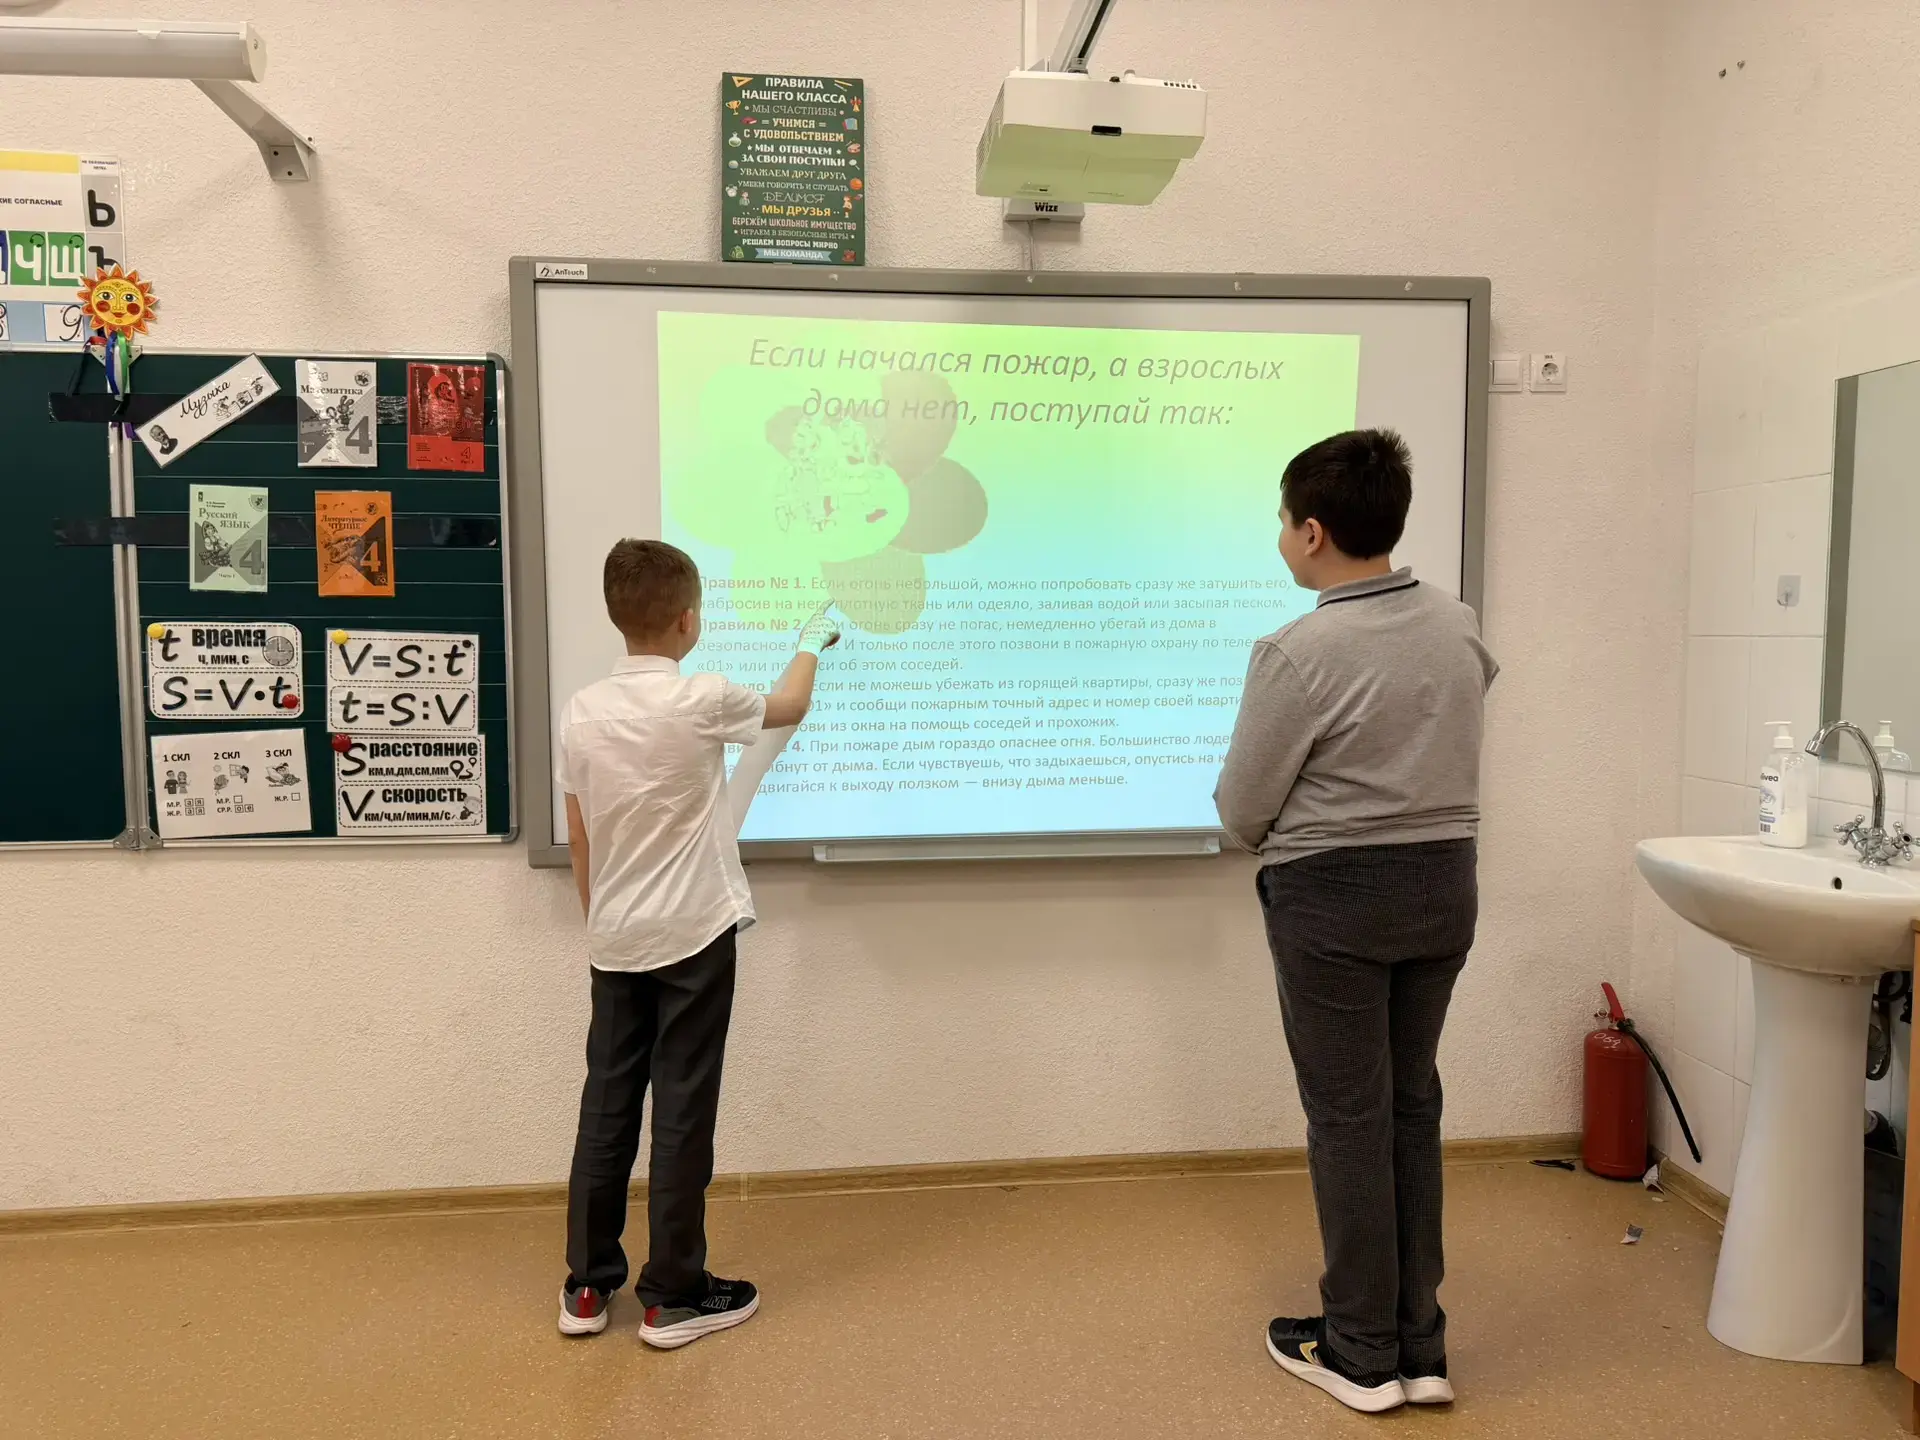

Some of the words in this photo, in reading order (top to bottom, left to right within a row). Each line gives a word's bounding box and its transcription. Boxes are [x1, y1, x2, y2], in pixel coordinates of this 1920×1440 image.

[765, 77, 824, 90] ПРАВИЛА
[741, 89, 794, 101] НАШЕГО
[796, 92, 848, 104] КЛАССА
[752, 104, 770, 114] МЫ
[772, 105, 838, 117] СЧАСТЛИВЫ
[772, 117, 816, 129] УЧИМСЯ
[743, 128, 751, 138] С
[753, 129, 845, 143] УДОВОЛЬСТВИЕМ
[755, 143, 775, 154] МЫ
[779, 144, 832, 156] ОТВЕЧАЕМ
[741, 153, 755, 163] ЗА
[756, 154, 786, 164] СВОИ
[789, 155, 846, 167] ПОСТУПКИ
[739, 167, 790, 178] УВАЖАЕМ
[791, 169, 816, 180] ДРУГ
[816, 170, 847, 180] ДРУГА
[737, 180, 766, 189] УМЕЕМ
[766, 180, 805, 190] ГОВОРИТЬ
[812, 183, 849, 193] СЛУШАТЬ
[14, 198, 63, 206] СОГЛАСНЫЕ
[761, 204, 784, 215] МЫ
[785, 206, 831, 217] ДРУЗЬЯ
[769, 218, 808, 229] ШКОЛЬНОЕ
[810, 220, 857, 231] ИМУЩЕСТВО
[742, 238, 774, 246] РЕШАЕМ
[775, 239, 811, 248] ВОПРОСЫ
[812, 241, 838, 250] МИРНО
[15, 243, 42, 281] Ч
[763, 249, 779, 257] МЫ
[780, 249, 824, 260] КОМАНДА
[749, 338, 826, 369] Если
[837, 348, 972, 374] начался
[982, 353, 1097, 383] пожар,
[1109, 356, 1128, 377] а
[1137, 357, 1285, 385] взрослых
[179, 381, 231, 420] Музыка
[802, 388, 890, 420] дома
[901, 399, 979, 426] нет,
[990, 397, 1151, 430] поступай
[1159, 403, 1234, 426] так:
[345, 415, 373, 455] 4
[198, 507, 239, 520] Русский
[239, 539, 265, 575] 4
[360, 541, 381, 572] 4
[699, 577, 766, 593] Правило
[770, 576, 789, 589] №
[811, 578, 846, 590] Если
[895, 578, 984, 592] небольшой,
[987, 580, 1037, 591] можно
[1040, 578, 1132, 592] попробовать
[1135, 579, 1174, 591] сразу
[1177, 579, 1196, 589] же
[1199, 579, 1262, 591] затушить
[1265, 579, 1291, 592] его,
[775, 600, 794, 610] на
[902, 600, 942, 610] ткань
[947, 600, 974, 610] или
[978, 600, 1033, 612] одеяло,
[1037, 600, 1093, 610] заливая
[1098, 597, 1140, 611] водой
[1144, 599, 1169, 609] или
[1174, 598, 1230, 609] засыпая
[1233, 598, 1286, 609] песком.
[699, 618, 766, 634] Правило
[770, 618, 788, 630] №
[894, 620, 934, 632] сразу
[939, 620, 956, 630] не
[960, 620, 1002, 632] погас,
[1006, 620, 1096, 632] немедленно
[1100, 617, 1146, 632] убегай
[1150, 619, 1165, 629] из
[1169, 619, 1205, 631] дома
[697, 639, 787, 651] безопасное
[859, 640, 908, 651] только
[912, 640, 955, 650] после
[959, 640, 996, 650] этого
[1000, 640, 1059, 650] позвони
[1075, 639, 1147, 651] пожарную
[1150, 638, 1198, 651] охрану
[1202, 638, 1219, 648] по
[697, 659, 733, 672] «01»
[739, 661, 767, 672] или
[839, 659, 858, 671] об
[861, 661, 897, 671] этом
[900, 657, 964, 672] соседей.
[848, 682, 866, 691] не
[869, 681, 932, 691] можешь
[936, 677, 994, 692] убежать
[998, 680, 1014, 689] из
[1018, 676, 1078, 691] горящей
[1082, 678, 1152, 691] квартиры,
[1156, 677, 1193, 690] сразу
[1197, 677, 1216, 687] же
[849, 699, 907, 712] сообщи
[911, 699, 989, 712] пожарным
[992, 696, 1044, 709] точный
[1048, 698, 1089, 711] адрес
[1105, 698, 1151, 710] номер
[1154, 694, 1193, 707] своей
[830, 721, 847, 732] из
[850, 720, 885, 731] окна
[889, 720, 907, 731] на
[911, 719, 970, 732] помощь
[973, 716, 1031, 731] соседей
[1047, 717, 1120, 730] прохожих.
[369, 741, 478, 759] расстояние
[810, 740, 839, 754] При
[843, 740, 899, 753] пожаре
[902, 740, 936, 752] дым
[939, 739, 996, 752] гораздо
[999, 737, 1057, 748] опаснее
[1060, 737, 1095, 747] огня.
[1099, 734, 1191, 747] Большинство
[163, 754, 169, 762] 1
[171, 753, 191, 762] СКЛ
[213, 752, 220, 760] 2
[221, 751, 241, 760] СКЛ
[265, 749, 272, 758] 3
[273, 749, 293, 757] СКЛ
[812, 762, 828, 772] от
[832, 761, 878, 774] дыма.
[882, 758, 915, 770] Если
[918, 758, 1004, 771] чувствуешь,
[1008, 757, 1031, 767] что
[1035, 755, 1131, 769] задыхаешься,
[1134, 753, 1194, 767] опустись
[841, 781, 894, 793] выходу
[898, 779, 960, 791] ползком
[982, 778, 1022, 790] внизу
[1025, 776, 1066, 790] дыма
[1068, 774, 1128, 786] меньше.
[381, 787, 467, 805] скорость
